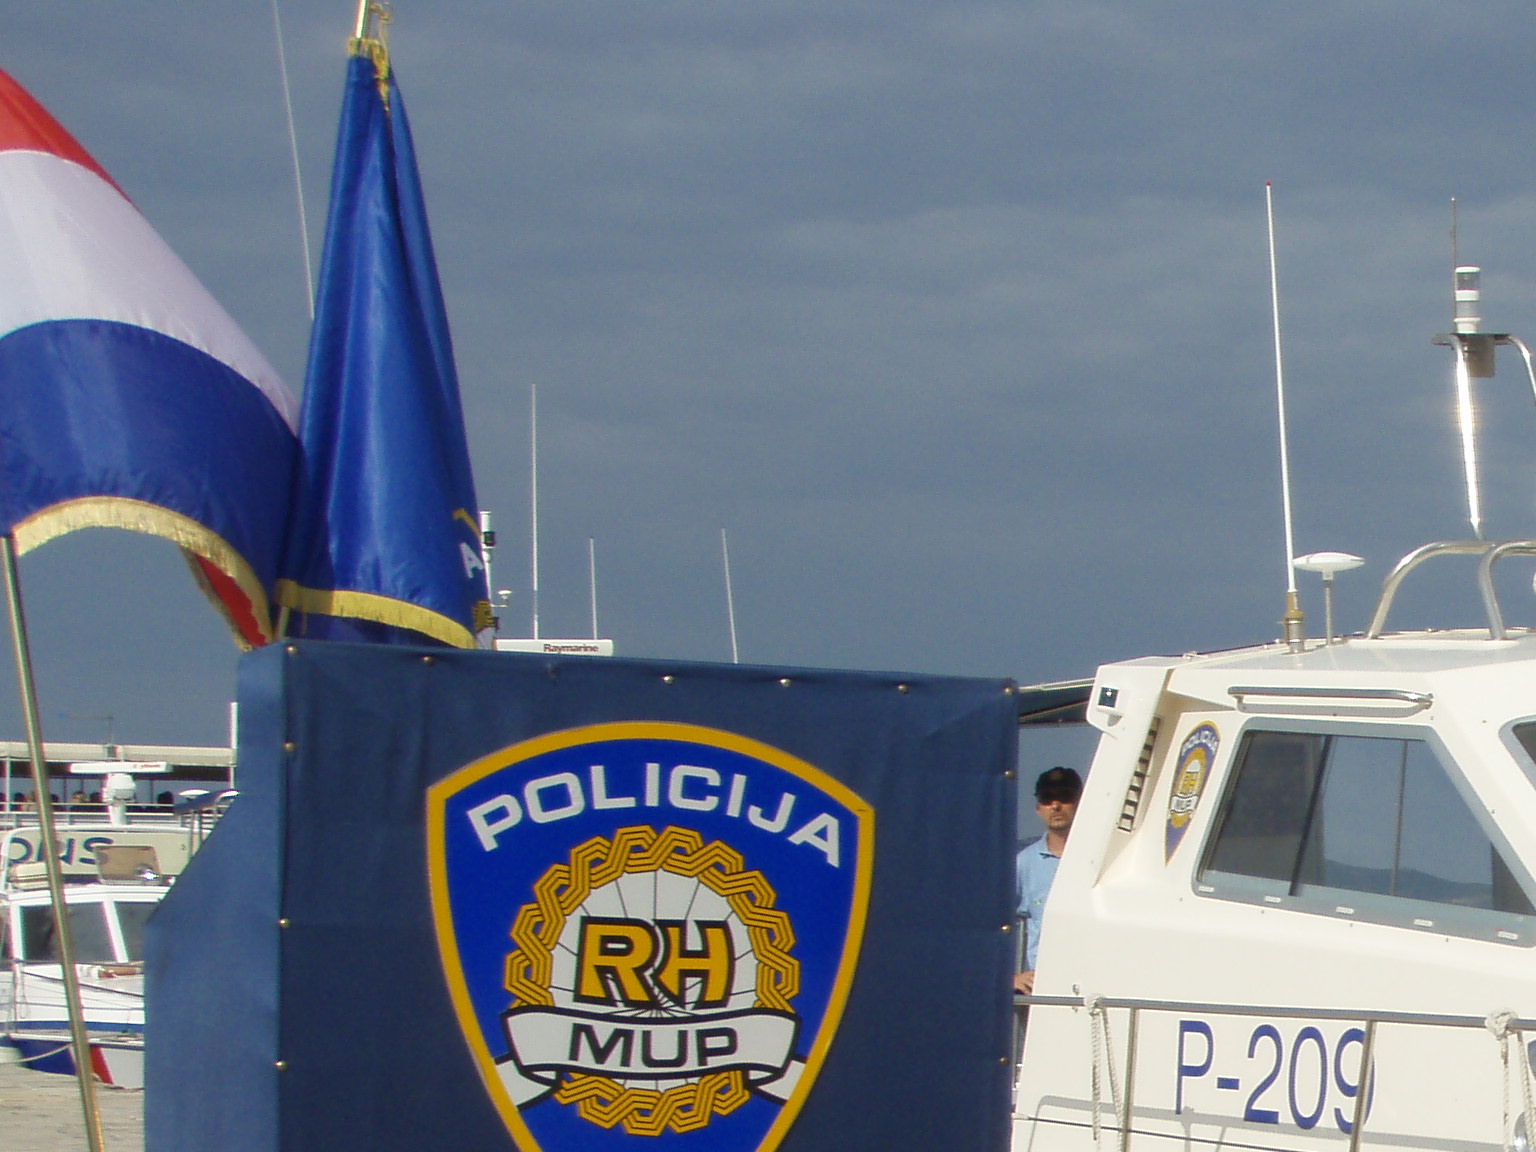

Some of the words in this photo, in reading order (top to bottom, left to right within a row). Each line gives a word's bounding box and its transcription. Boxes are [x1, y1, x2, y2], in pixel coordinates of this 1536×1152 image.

[543, 643, 599, 653] Raymarine
[467, 762, 841, 868] POLICIJA
[574, 915, 735, 1010] RH
[569, 1022, 739, 1068] MUP
[1175, 1020, 1375, 1135] P-209
